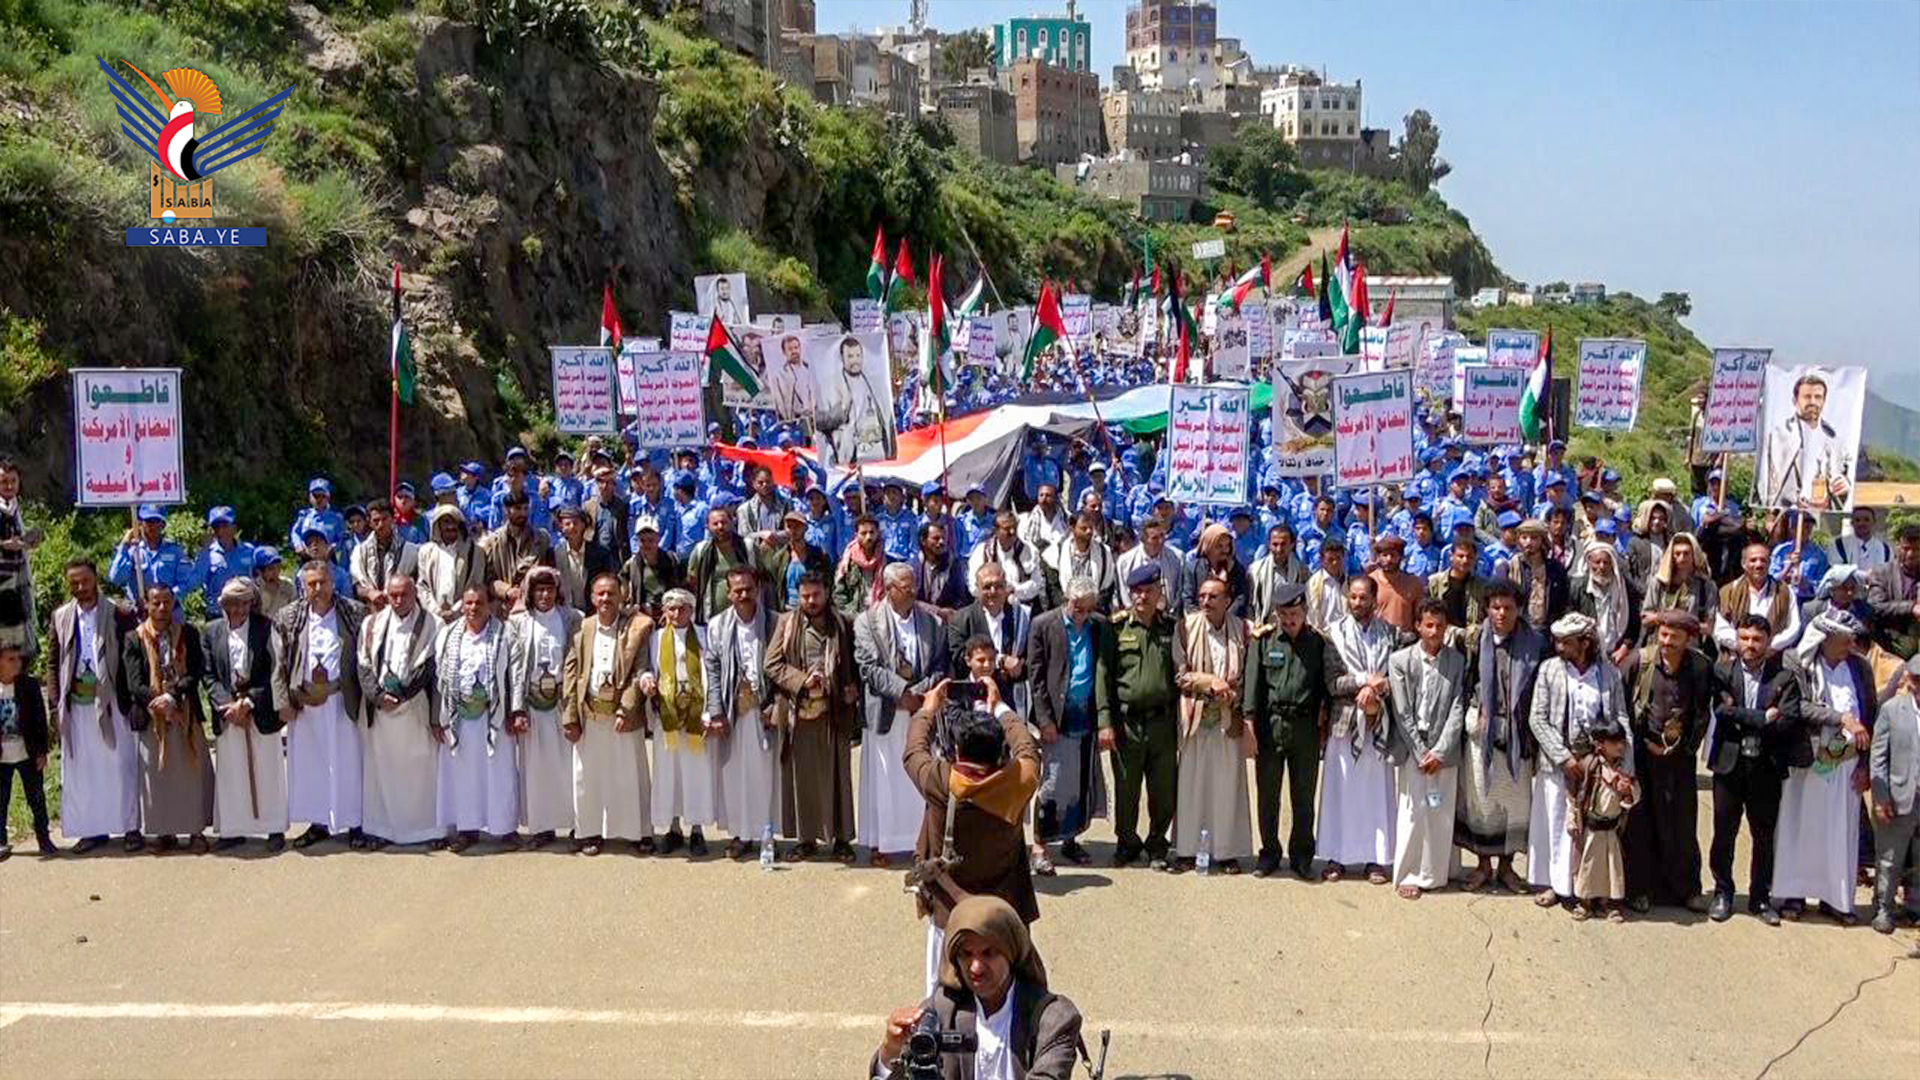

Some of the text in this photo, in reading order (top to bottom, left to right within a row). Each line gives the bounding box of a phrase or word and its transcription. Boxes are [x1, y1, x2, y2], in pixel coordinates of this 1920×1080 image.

[558, 350, 609, 371] الله أكبر
[639, 355, 672, 377] أكبر
[674, 357, 696, 372] الله
[1470, 371, 1518, 390] قاطعوا
[84, 376, 169, 410] قاطعوا
[1175, 389, 1246, 416] الله أكبر
[1338, 375, 1405, 411] قاطعوا
[134, 416, 176, 442] البضائع
[125, 444, 132, 466] و
